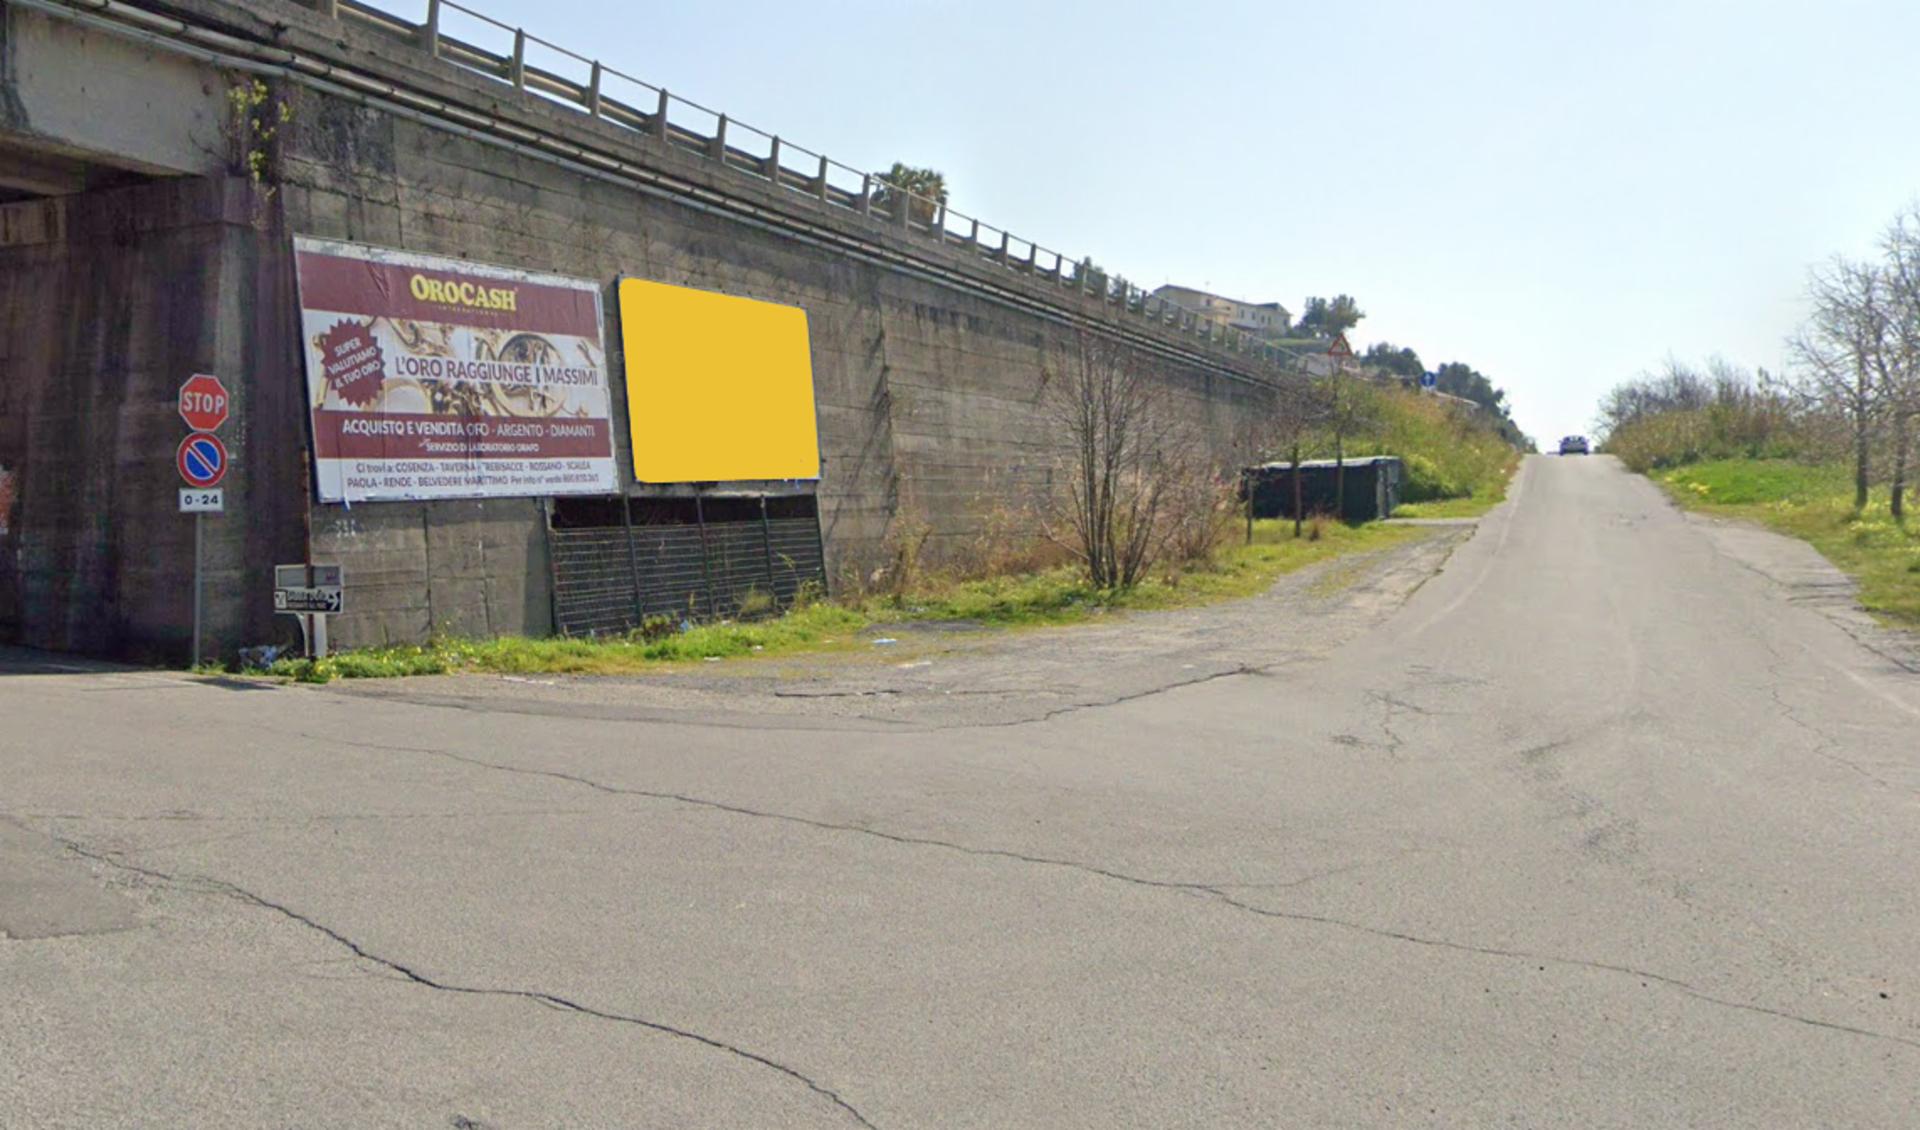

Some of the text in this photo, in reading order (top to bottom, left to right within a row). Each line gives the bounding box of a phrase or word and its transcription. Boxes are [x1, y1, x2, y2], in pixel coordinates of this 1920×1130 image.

[411, 274, 516, 311] OROCASH
[395, 356, 443, 377] L'ORO
[446, 360, 532, 383] RAGGIUNGE
[543, 367, 598, 386] MASSIMI
[182, 391, 225, 415] STOP
[342, 419, 405, 437] ACQUISTO
[406, 421, 414, 435] E
[415, 422, 465, 436] VENDITA
[496, 424, 544, 437] ARGENTO
[550, 425, 595, 437] DIAMANTI
[201, 494, 219, 505] 24
